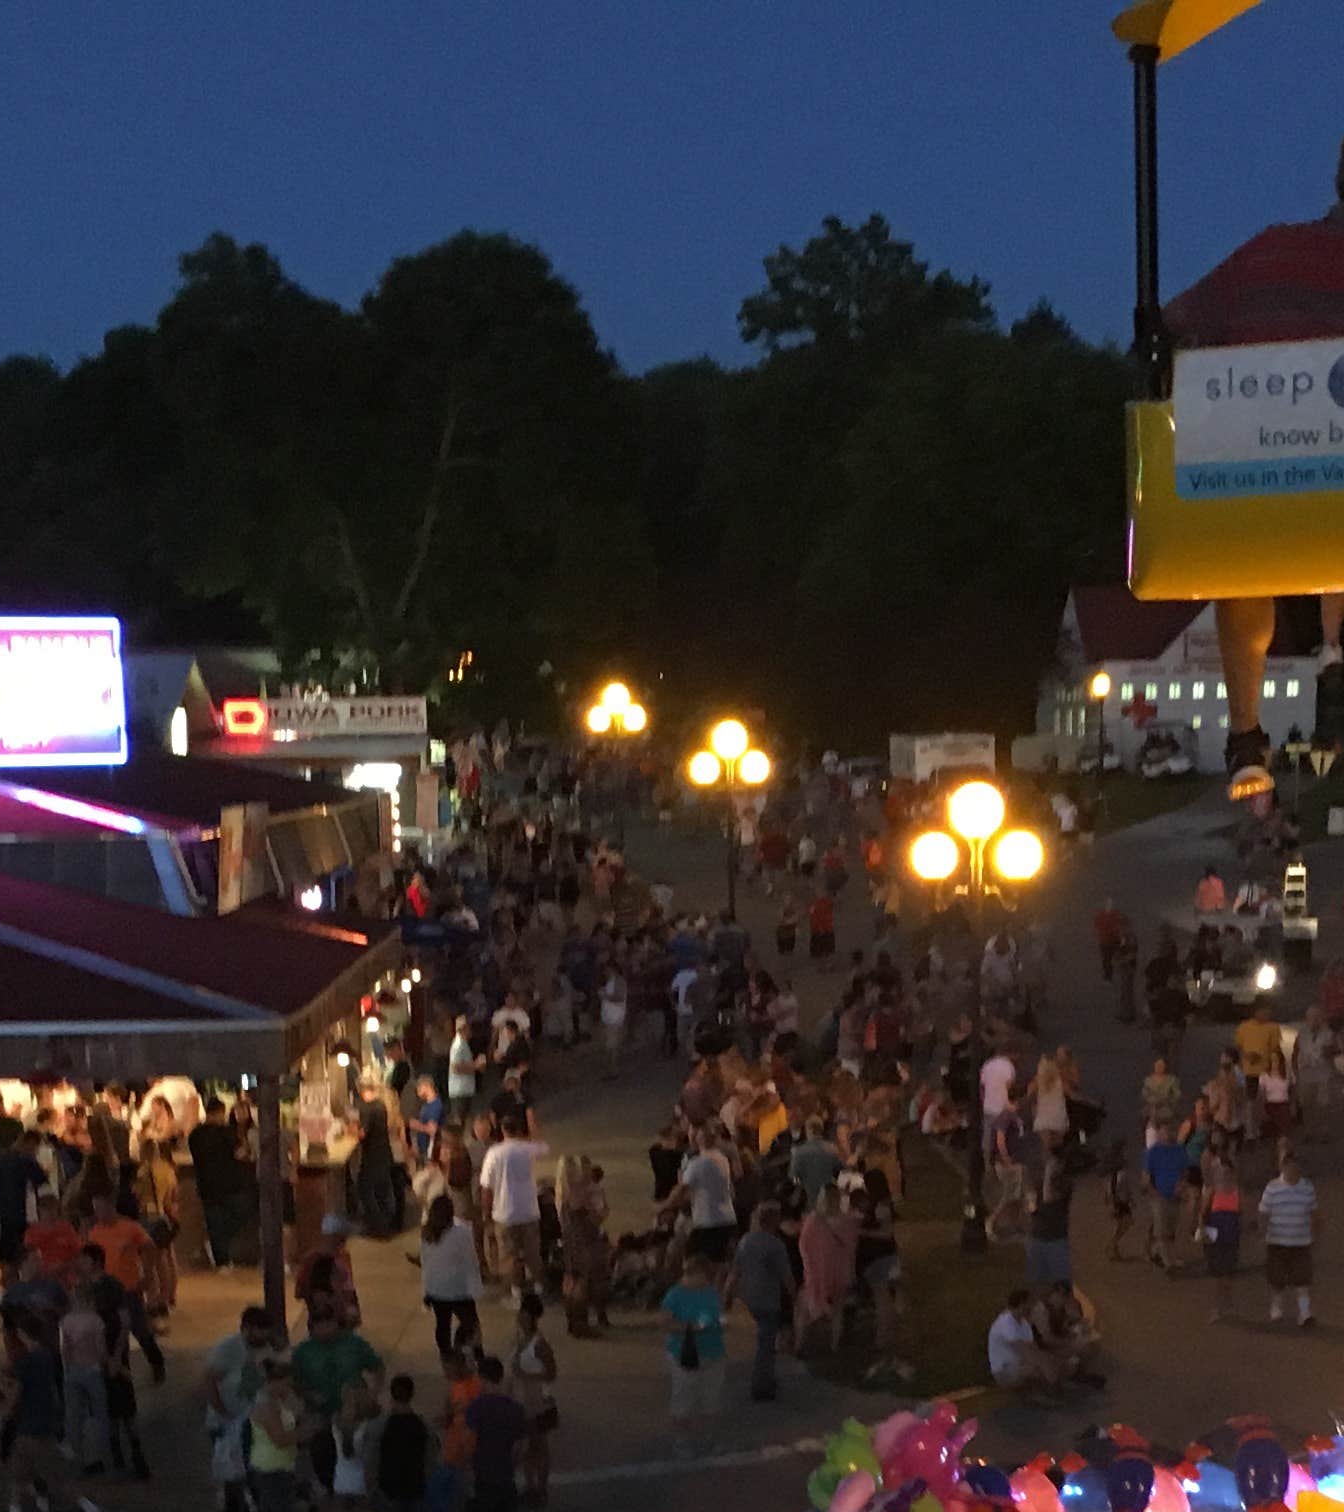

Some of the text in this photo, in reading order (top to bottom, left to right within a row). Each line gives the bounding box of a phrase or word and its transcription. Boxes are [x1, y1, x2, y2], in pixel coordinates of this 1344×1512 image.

[1206, 367, 1314, 405] sleep
[1258, 425, 1320, 447] know
[1188, 470, 1228, 492] Visit
[1234, 474, 1256, 488] us
[1261, 467, 1279, 486] in
[1283, 464, 1317, 485] the
